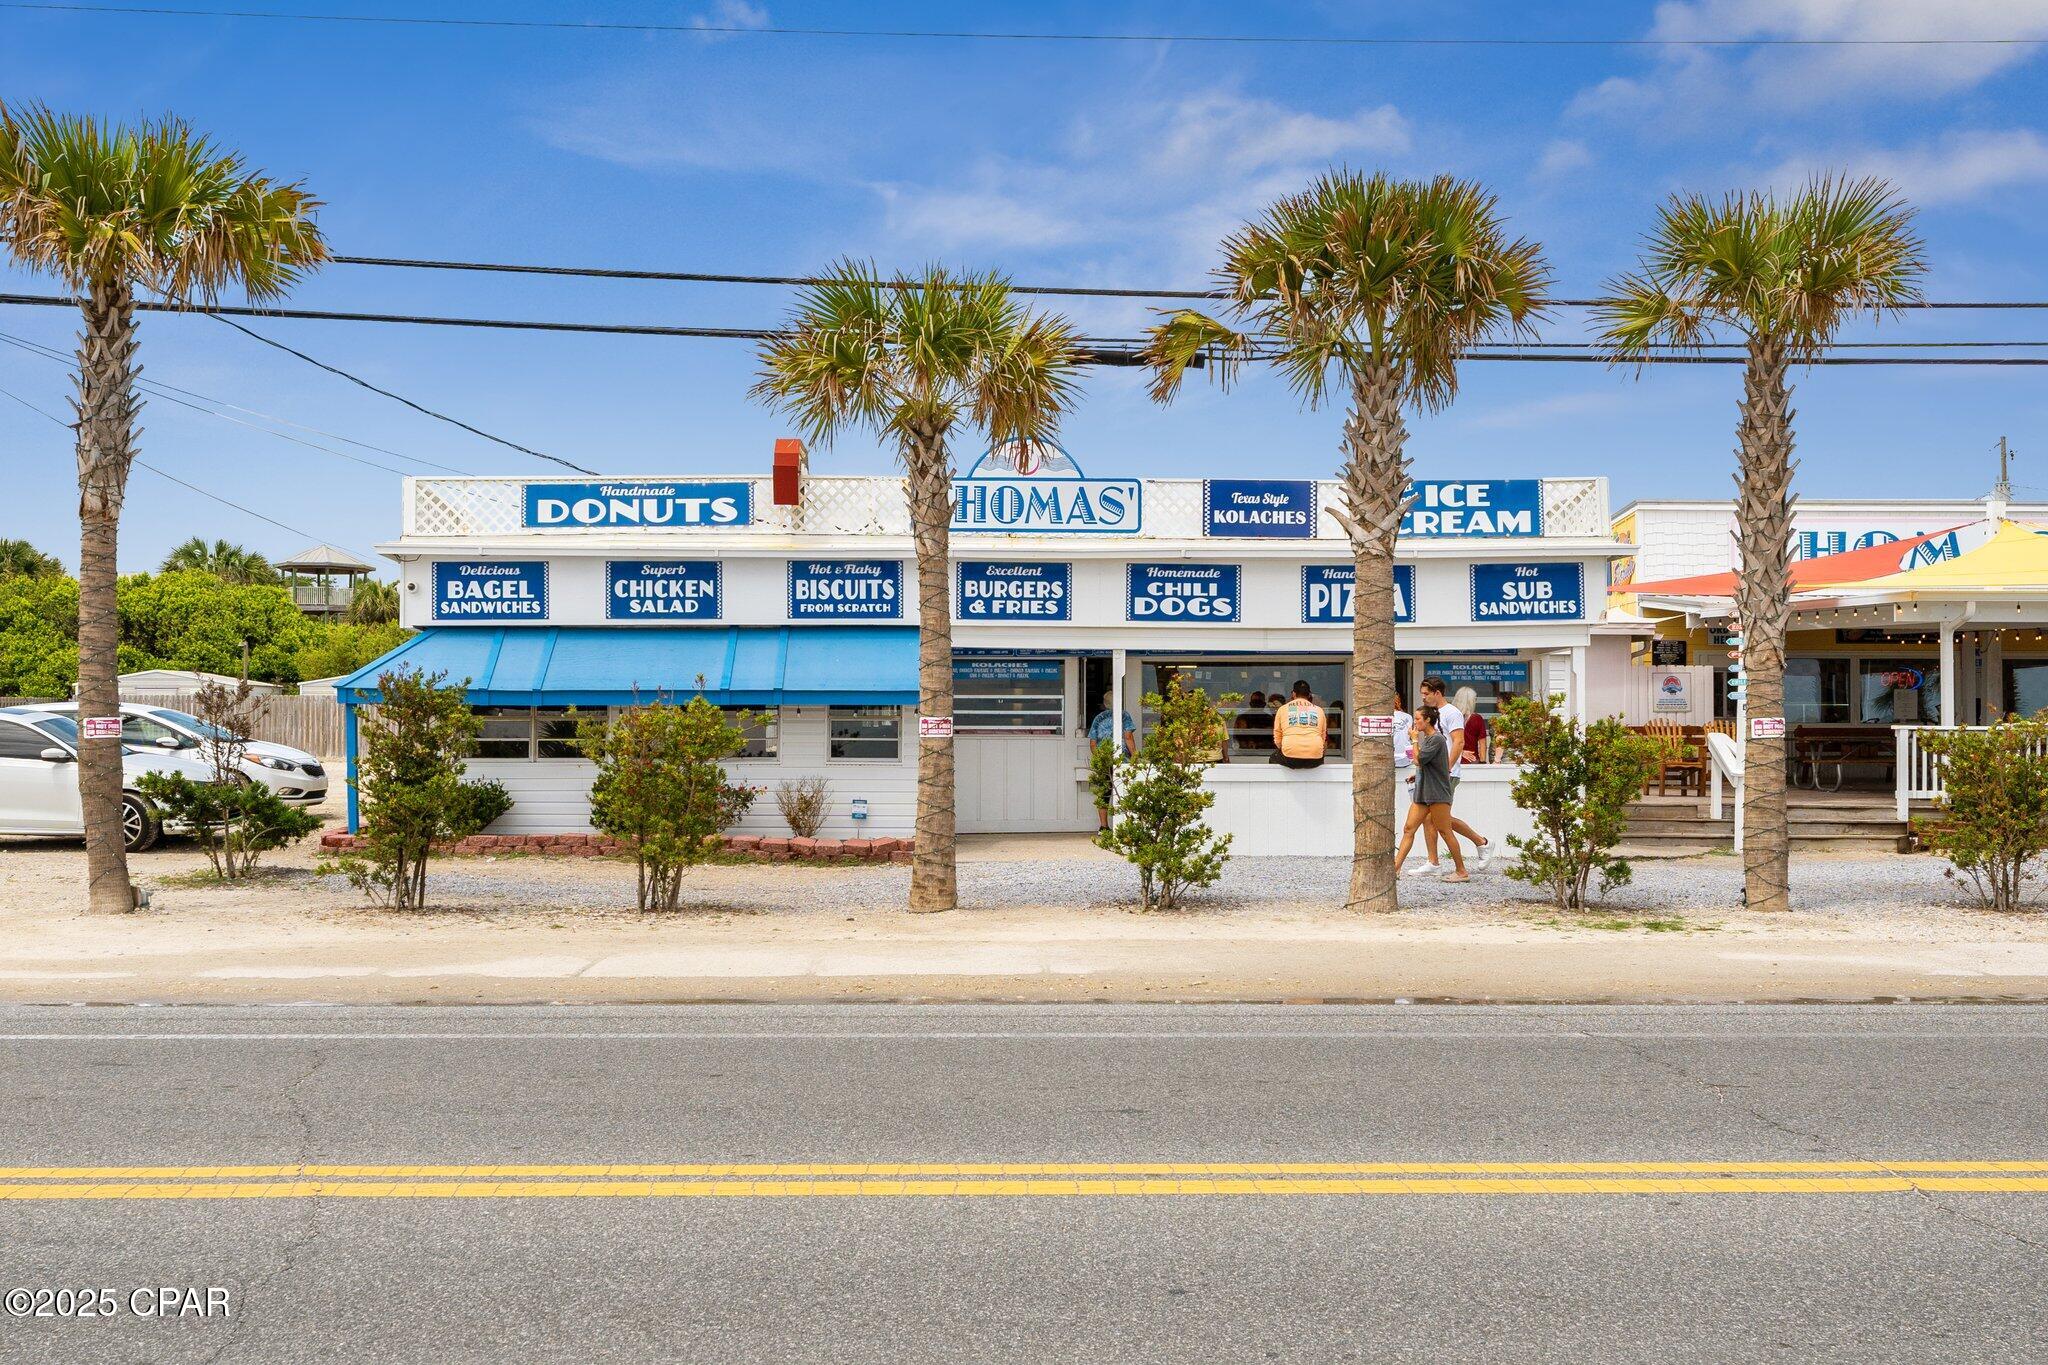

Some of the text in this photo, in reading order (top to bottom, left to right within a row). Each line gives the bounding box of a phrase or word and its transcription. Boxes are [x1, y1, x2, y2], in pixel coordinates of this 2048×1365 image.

[600, 485, 676, 497] Handmade
[1425, 484, 1491, 508] ICE
[949, 485, 1134, 526] HOMAS'
[1231, 492, 1290, 508] Texas Style
[537, 497, 738, 524] DONUTS
[1213, 509, 1307, 525] KOLACHES
[459, 564, 521, 576] Delicious
[641, 564, 686, 577] Superb
[808, 564, 882, 577] Hot & Flaky
[986, 565, 1043, 576] Excellent
[1146, 567, 1221, 578] Homemade
[1514, 566, 1540, 577] Hot
[447, 580, 535, 599] BAGEL
[614, 579, 714, 598] CHICKEN
[795, 579, 895, 600] BISCUITS
[964, 580, 1064, 599] BURGERS
[1147, 581, 1217, 596] CHILI
[1502, 581, 1553, 600] SUB
[440, 601, 541, 614] SANDWICHES
[629, 599, 699, 613] SALAD
[968, 599, 1058, 614] & FRIES
[1134, 597, 1233, 616] DOGS
[1309, 583, 1408, 617] PIZA
[1479, 600, 1577, 615] SANDWICHES
[800, 603, 891, 613] FROM SCRATCH
[1880, 671, 1916, 689] OPEN
